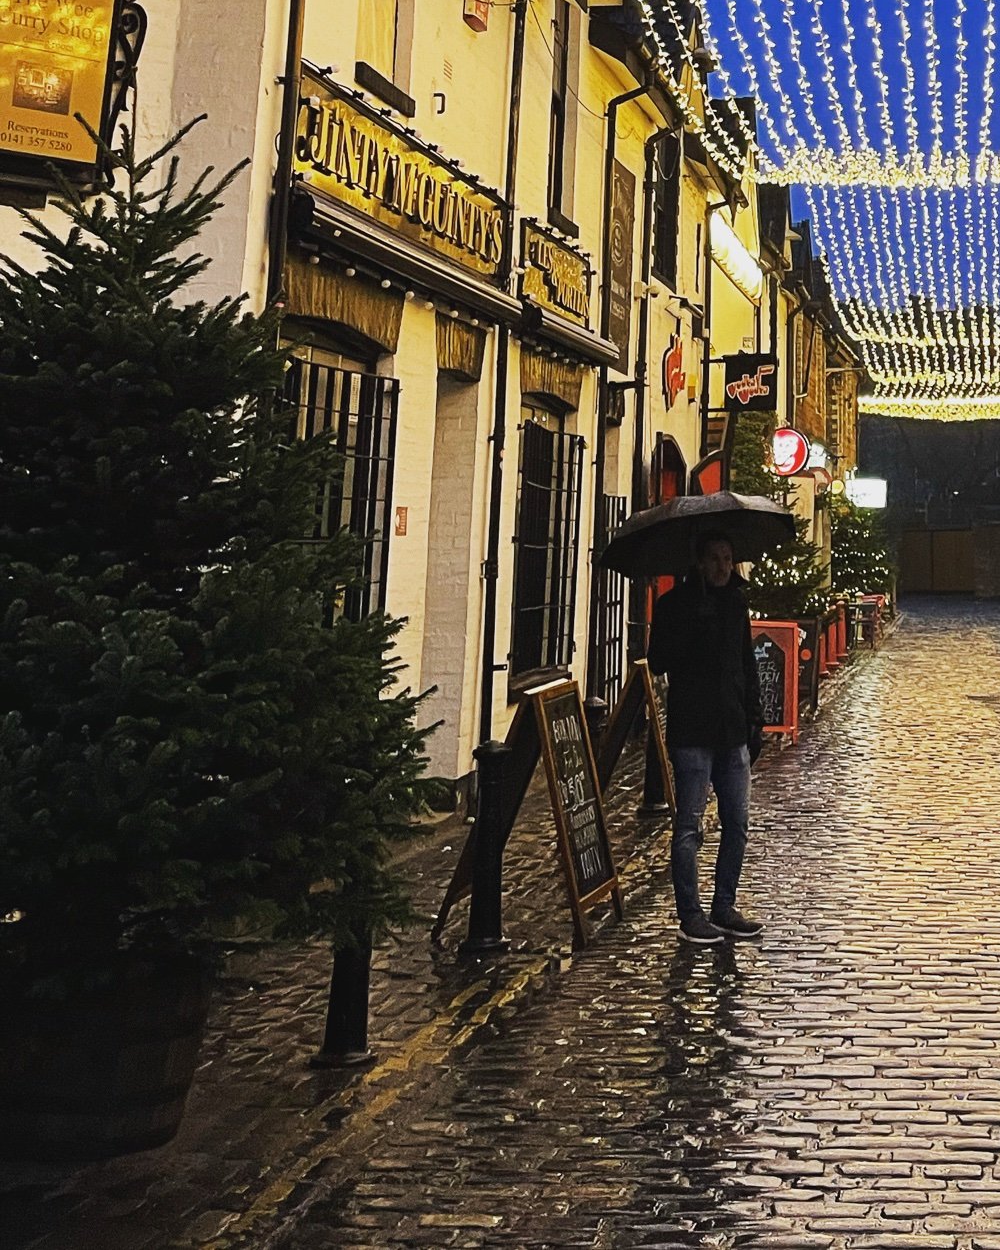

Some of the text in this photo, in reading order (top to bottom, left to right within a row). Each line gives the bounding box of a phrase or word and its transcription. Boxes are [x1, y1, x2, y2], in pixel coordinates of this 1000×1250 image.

[57, 17, 105, 46] Shop
[7, 120, 69, 140] Reservations
[0, 132, 73, 152] 0141 357 5280
